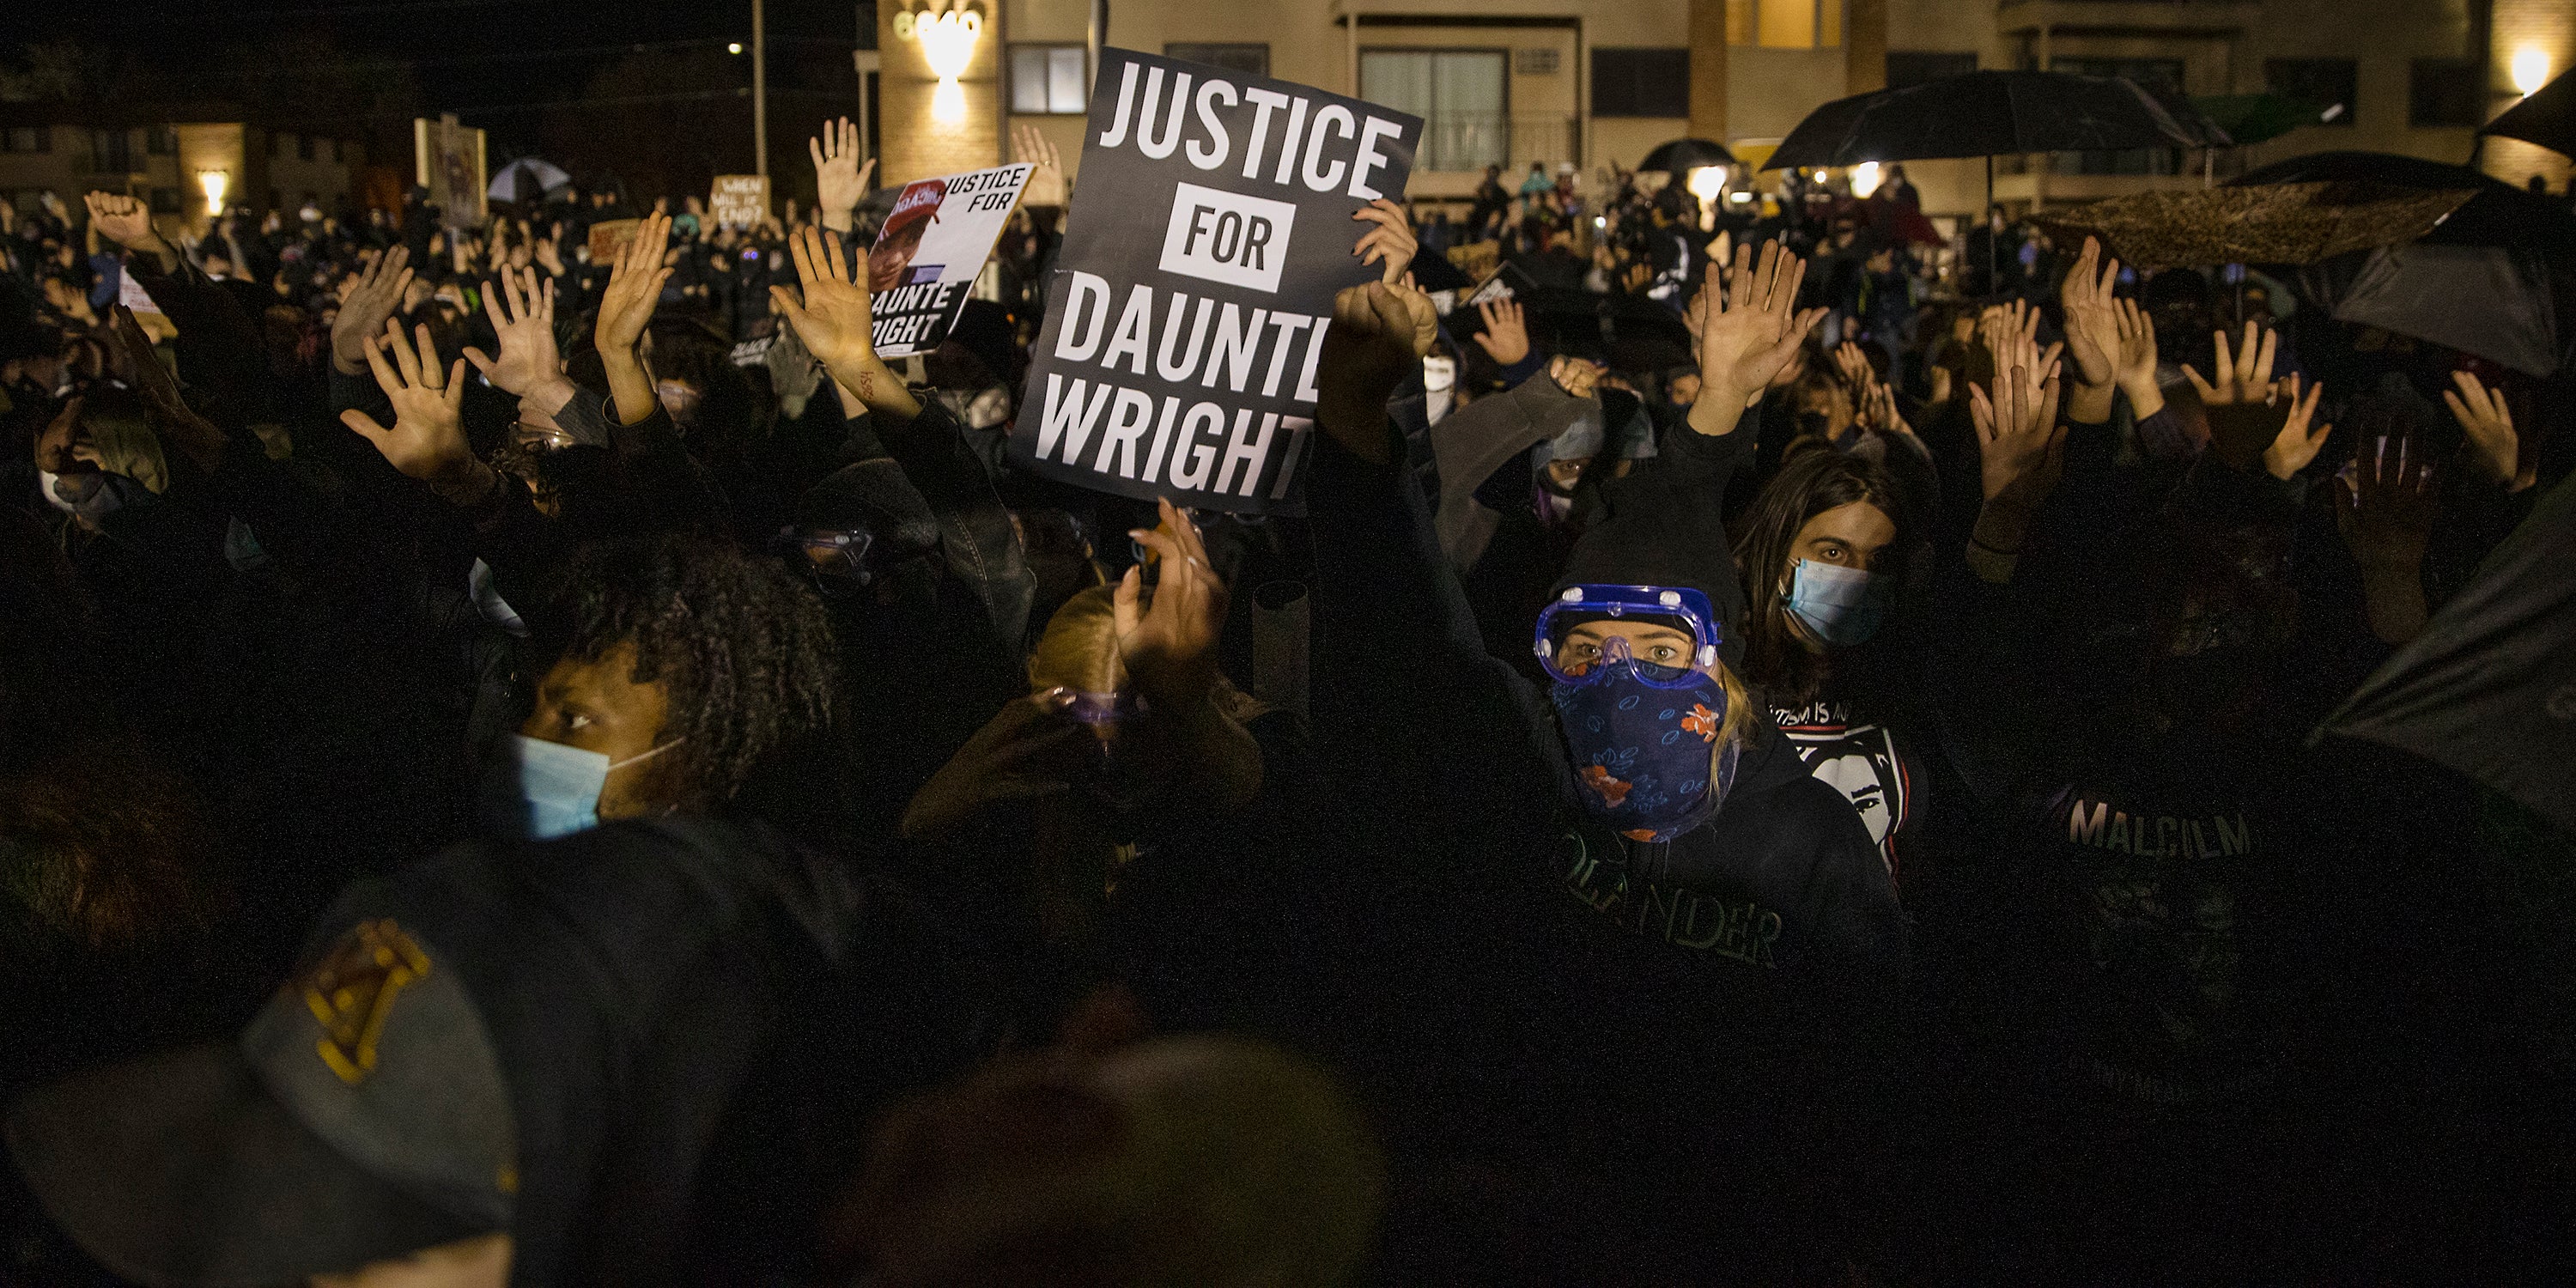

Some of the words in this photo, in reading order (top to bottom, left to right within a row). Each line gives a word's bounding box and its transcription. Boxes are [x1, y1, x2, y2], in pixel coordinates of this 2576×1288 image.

[1099, 61, 1402, 200] JUSTICE
[721, 178, 762, 193] WHEN
[937, 167, 1026, 196] JUSTICE
[968, 191, 1014, 213] FOR
[1183, 204, 1273, 270] FOR
[870, 280, 958, 316] AUNTE
[872, 313, 942, 347] IGHT
[1036, 373, 1314, 501] WRIGHT
[1814, 702, 1830, 724] IS
